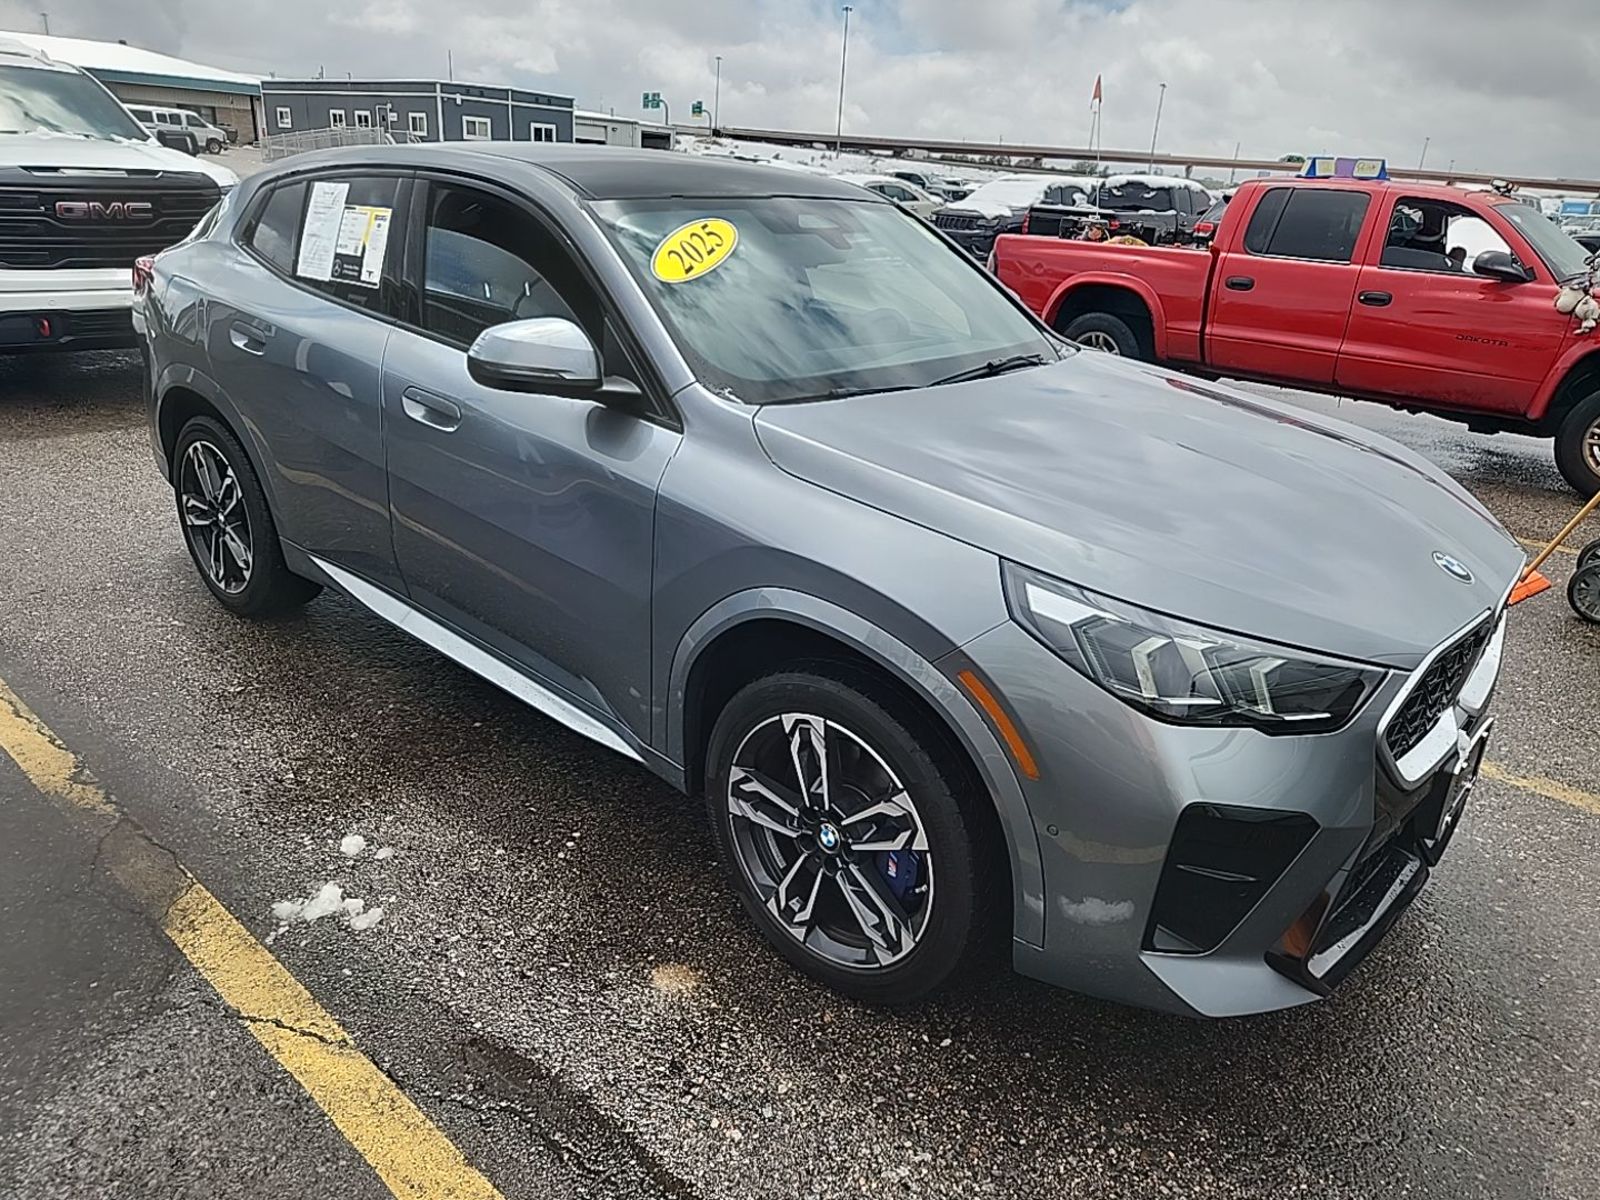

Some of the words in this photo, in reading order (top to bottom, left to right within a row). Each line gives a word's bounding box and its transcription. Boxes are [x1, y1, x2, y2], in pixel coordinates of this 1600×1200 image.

[55, 201, 153, 219] GMC
[667, 223, 724, 275] 2025
[1455, 334, 1508, 347] DAKOTA
